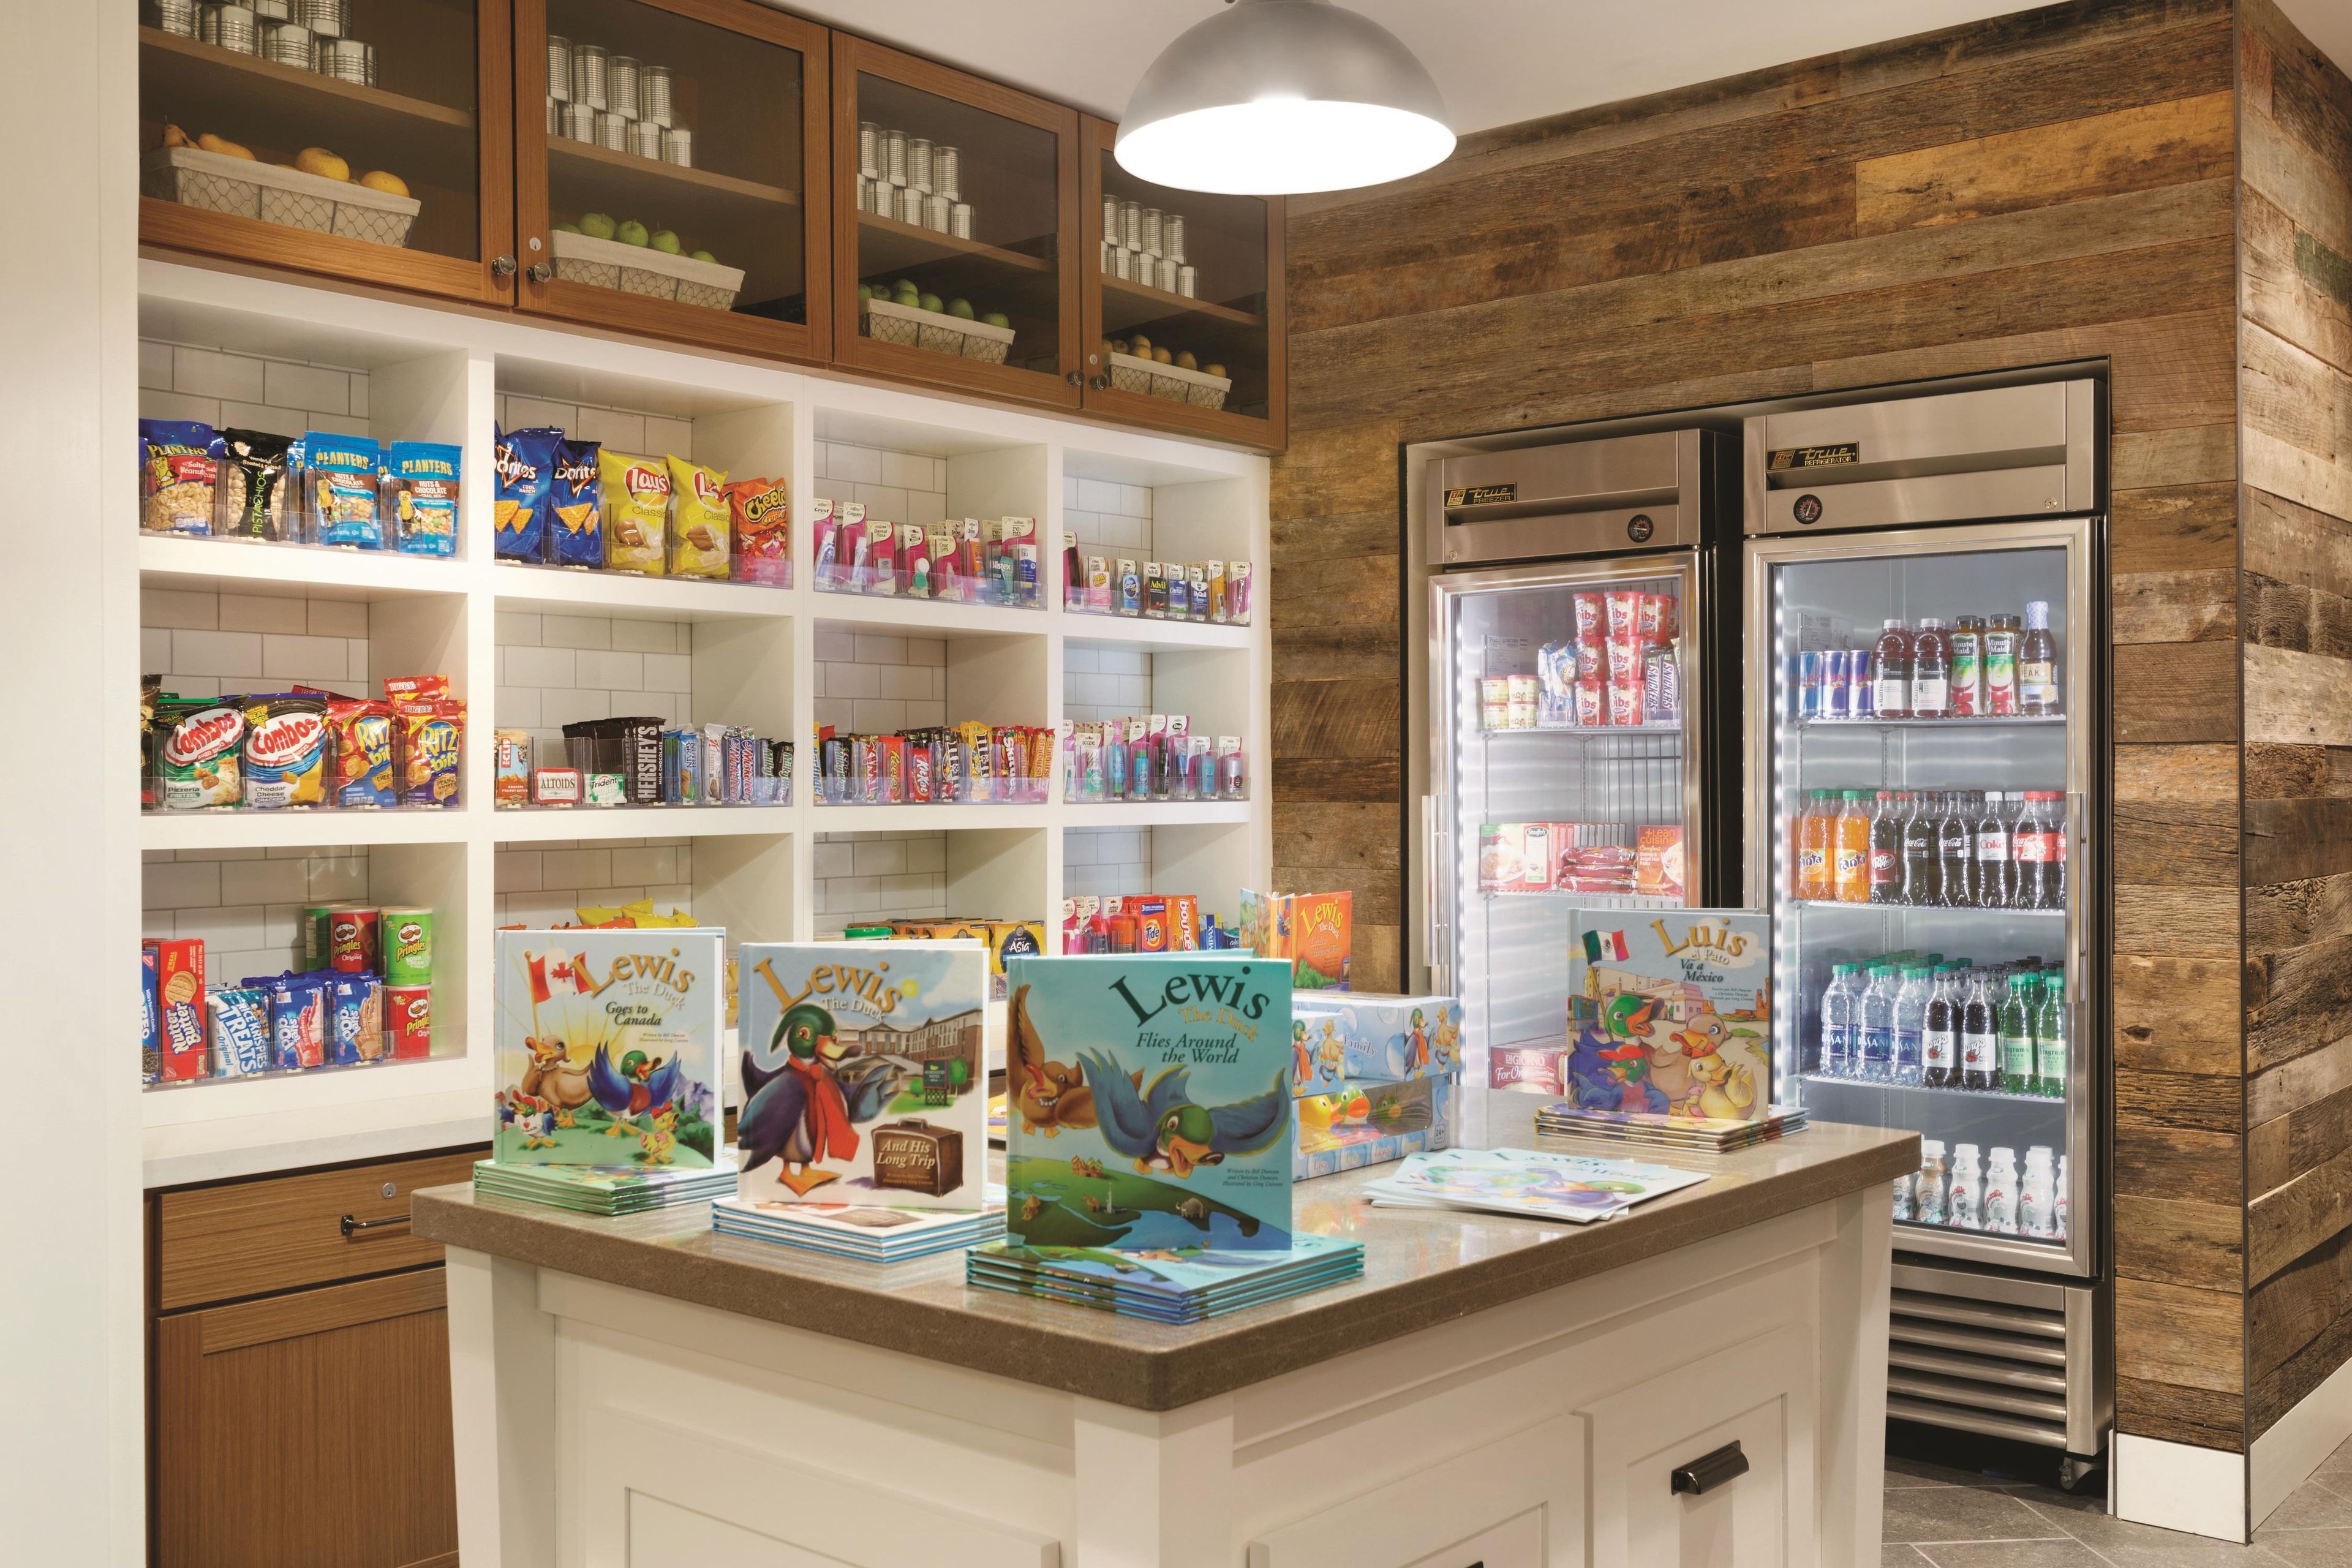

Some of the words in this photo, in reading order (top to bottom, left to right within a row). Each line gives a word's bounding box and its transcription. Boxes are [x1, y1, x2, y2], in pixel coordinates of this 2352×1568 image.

[147, 445, 207, 457] PLANTERS
[243, 459, 260, 469] Roasted
[315, 451, 369, 470] PLANTERS
[402, 460, 453, 476] PLANTERS
[1804, 456, 1852, 466] REFRIGERATOR
[331, 476, 364, 486] CHOCOLATE
[632, 468, 668, 493] Lay's
[252, 471, 266, 533] PISTACHIOS
[990, 560, 1011, 572] Blistex
[1150, 581, 1166, 589] Advil
[1648, 666, 1658, 713] SNICKERS
[1662, 662, 1674, 709] SNICKERS
[248, 710, 265, 720] REAL
[251, 715, 270, 725] CHEESE
[173, 713, 236, 755] Combos
[252, 718, 318, 755] Combos
[421, 726, 459, 756] RITZ
[198, 750, 211, 761] BAKED
[502, 738, 511, 760] CLIF
[431, 752, 458, 772] bits
[638, 726, 657, 799] HERSHEY'S
[762, 748, 774, 775] Milky
[780, 752, 793, 777] Milky
[834, 747, 844, 772] Milky
[1003, 737, 1016, 796] Skittles
[541, 777, 575, 789] ALTOIDS
[590, 777, 618, 790] Trident
[594, 785, 617, 796] White
[1905, 837, 1928, 848] Coca-Cola
[1939, 837, 1962, 848] Coca-Cola
[1980, 839, 2005, 850] Coke
[1179, 899, 1192, 951] bounce
[1300, 899, 1343, 939] Lewis
[1145, 926, 1159, 942] Tide
[1318, 922, 1328, 933] The
[1328, 922, 1340, 940] Duck
[1650, 916, 1748, 958] Luis
[334, 940, 361, 960] Pringles
[397, 941, 426, 962] Pringles
[1009, 941, 1030, 952] Asia
[1681, 959, 1694, 970] Va
[1690, 948, 1700, 961] el
[1705, 948, 1730, 965] Pato
[567, 948, 695, 999] Lewis
[1684, 971, 1724, 982] México
[753, 957, 902, 1014] Lewis
[623, 981, 650, 995] The
[653, 983, 686, 1010] Duck
[1109, 966, 1271, 1027] Lewis
[605, 1001, 633, 1016] Goes
[637, 1005, 648, 1014] to
[821, 997, 848, 1011] The
[850, 1000, 886, 1022] Duck
[176, 1001, 202, 1045] Butter
[614, 1013, 662, 1025] Canada
[1178, 1005, 1212, 1024] The
[1216, 1006, 1260, 1042] Duck
[167, 1009, 189, 1055] Nutter
[216, 1005, 256, 1072] TREATS
[237, 1001, 253, 1023] RICE
[249, 1023, 268, 1069] KRISPIES
[1136, 1033, 1171, 1049] Flies
[1175, 1033, 1237, 1049] Around
[218, 1036, 233, 1066] Original
[1344, 1033, 1377, 1058] family
[1162, 1049, 1186, 1064] the
[1192, 1049, 1238, 1065] World
[1495, 1067, 1510, 1082] For
[1435, 1129, 1445, 1137] 24+
[881, 1139, 907, 1152] And
[909, 1141, 931, 1153] His
[1373, 1147, 1393, 1158] Lewis
[876, 1152, 907, 1168] Long
[910, 1153, 936, 1169] Trip
[1313, 1158, 1328, 1170] Lisa
